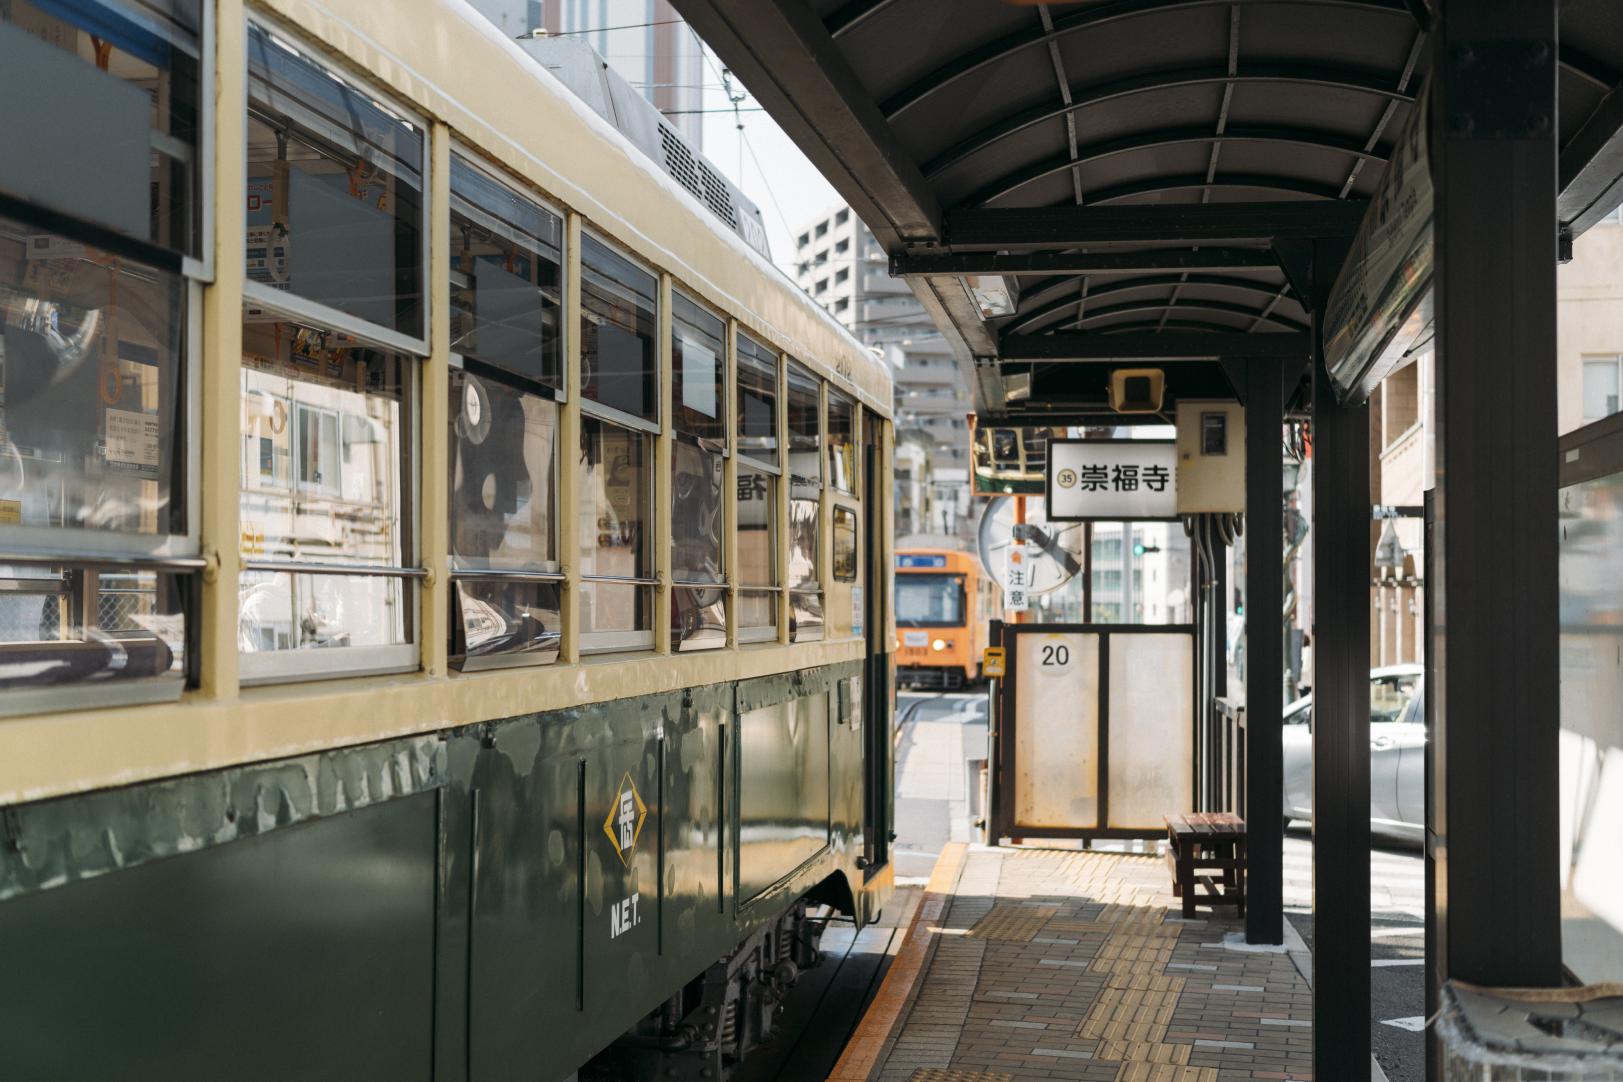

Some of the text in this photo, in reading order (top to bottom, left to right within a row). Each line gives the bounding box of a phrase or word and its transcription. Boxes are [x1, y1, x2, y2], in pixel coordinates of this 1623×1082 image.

[1061, 474, 1073, 484] 35
[1080, 464, 1170, 492] 崇福寺
[1009, 569, 1025, 606] 注意
[1041, 645, 1070, 666] 20
[610, 892, 641, 940] N.E.T.
